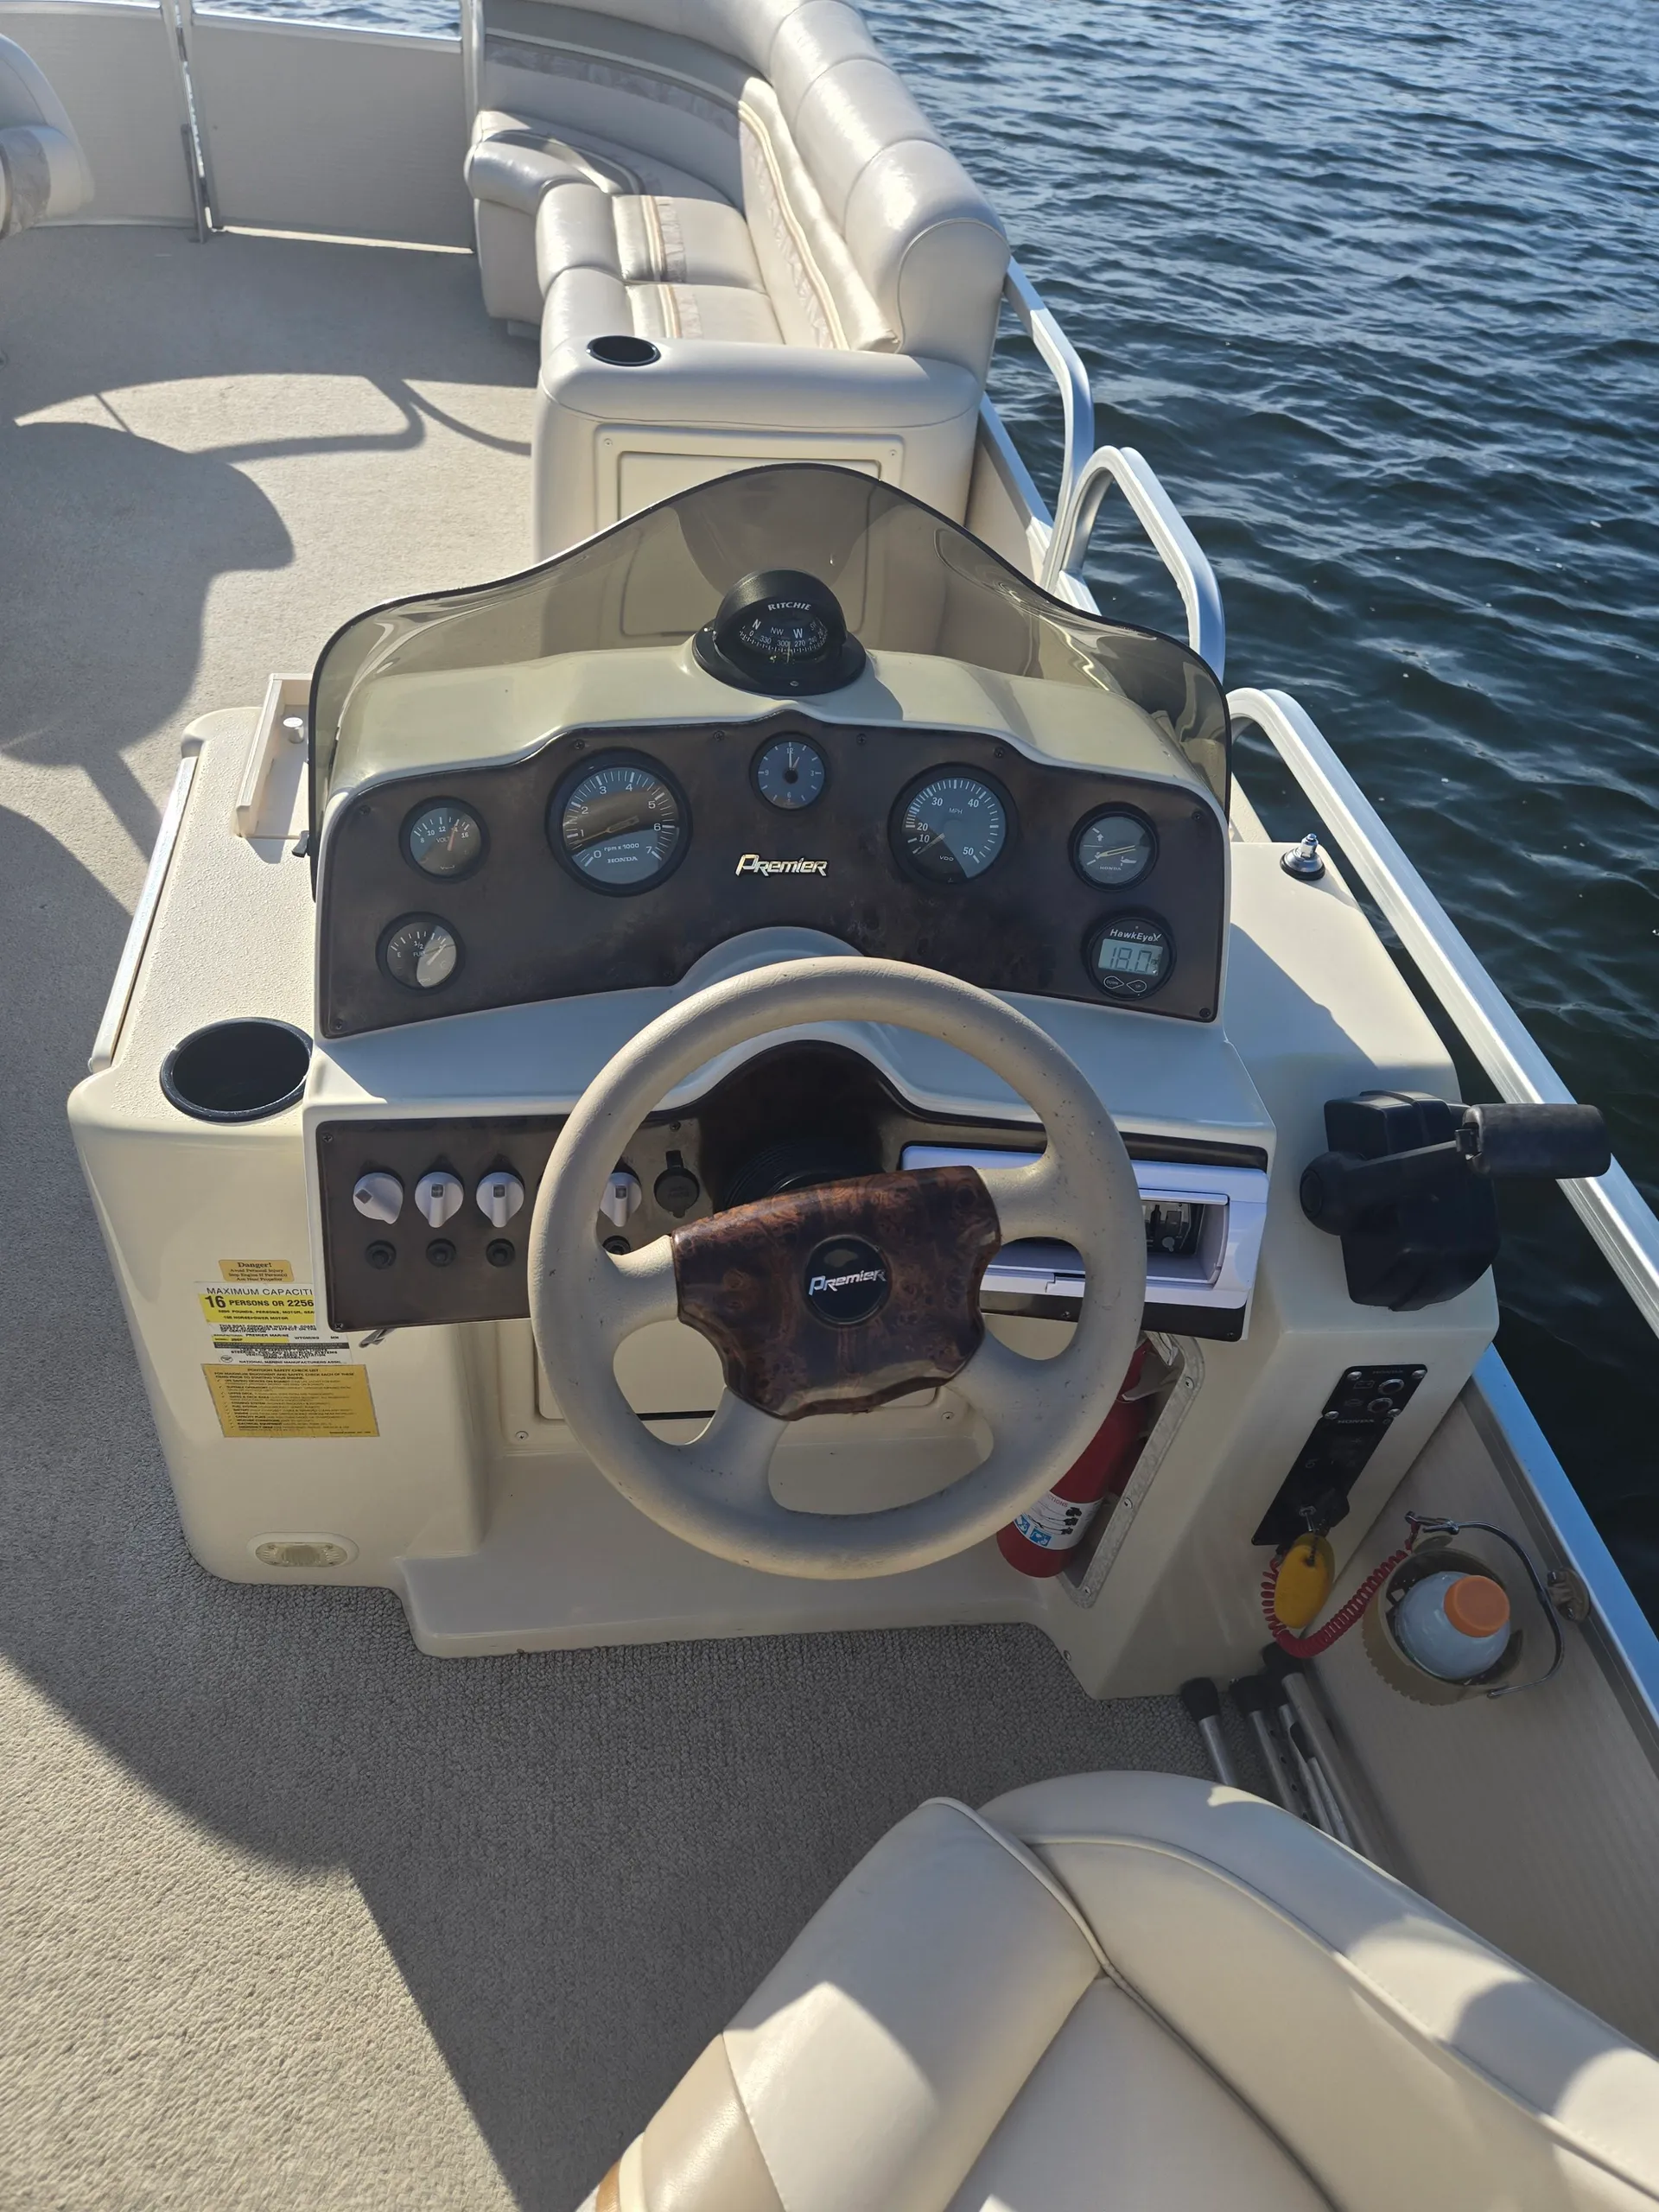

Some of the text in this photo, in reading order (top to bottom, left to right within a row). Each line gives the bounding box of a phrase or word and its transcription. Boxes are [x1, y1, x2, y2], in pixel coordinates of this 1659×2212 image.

[767, 601, 811, 611] RITCHIE
[752, 619, 761, 630] N
[770, 626, 784, 635] NW
[793, 628, 803, 639] W
[760, 635, 772, 644] 330
[648, 800, 656, 809] 5
[931, 798, 943, 806] 30
[968, 798, 979, 808] 40
[582, 806, 588, 815] 2
[653, 823, 661, 831] 6
[917, 823, 928, 831] 20
[918, 834, 930, 842] 10
[593, 850, 601, 859] 0
[963, 847, 974, 855] 50
[1109, 929, 1156, 942] HawkEye
[205, 1295, 226, 1308] 16
[1047, 1494, 1069, 1508] CTIONS
